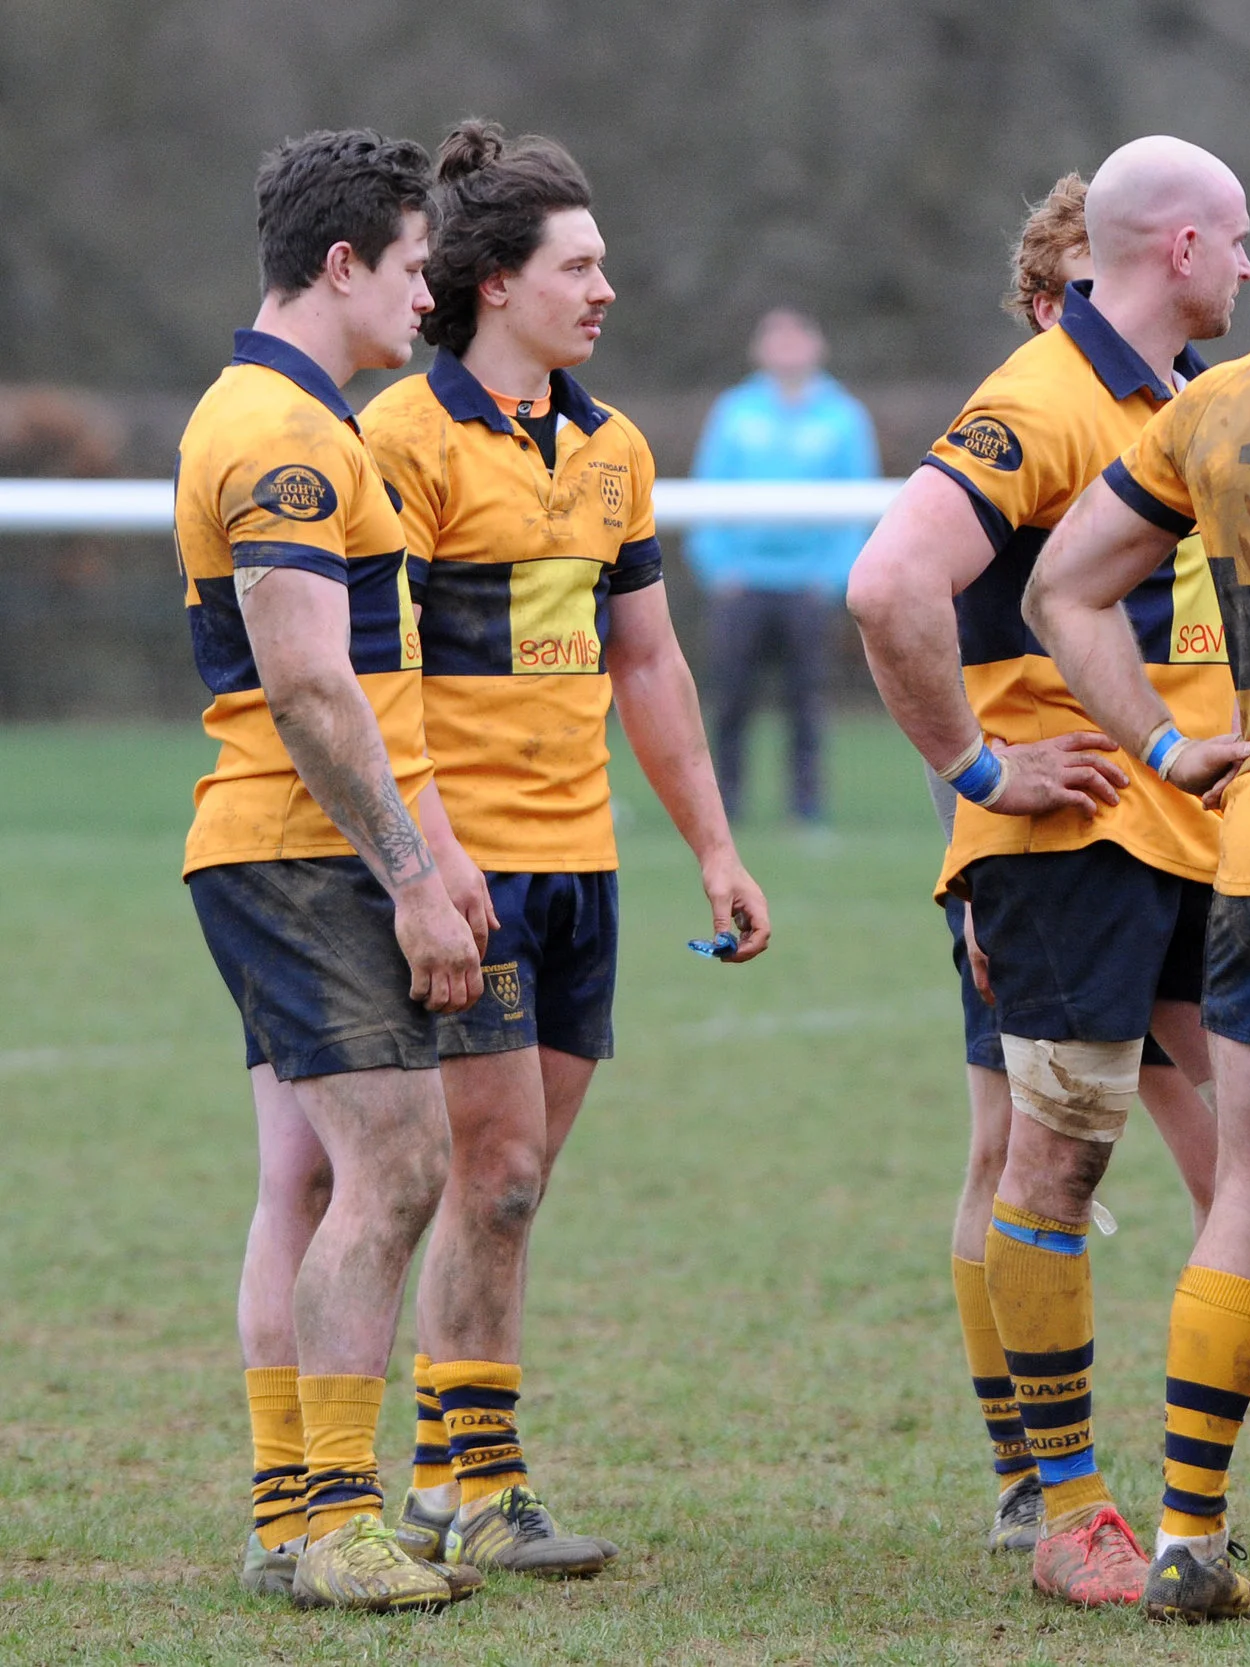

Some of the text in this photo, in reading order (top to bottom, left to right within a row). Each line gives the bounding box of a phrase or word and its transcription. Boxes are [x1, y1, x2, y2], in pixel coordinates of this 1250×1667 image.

[960, 427, 1012, 454] MIGHTY
[964, 438, 999, 460] OAKS
[269, 482, 326, 498] MIGHTY
[280, 493, 318, 507] OAKS
[519, 630, 599, 667] savills
[1021, 1377, 1087, 1396] OAKS
